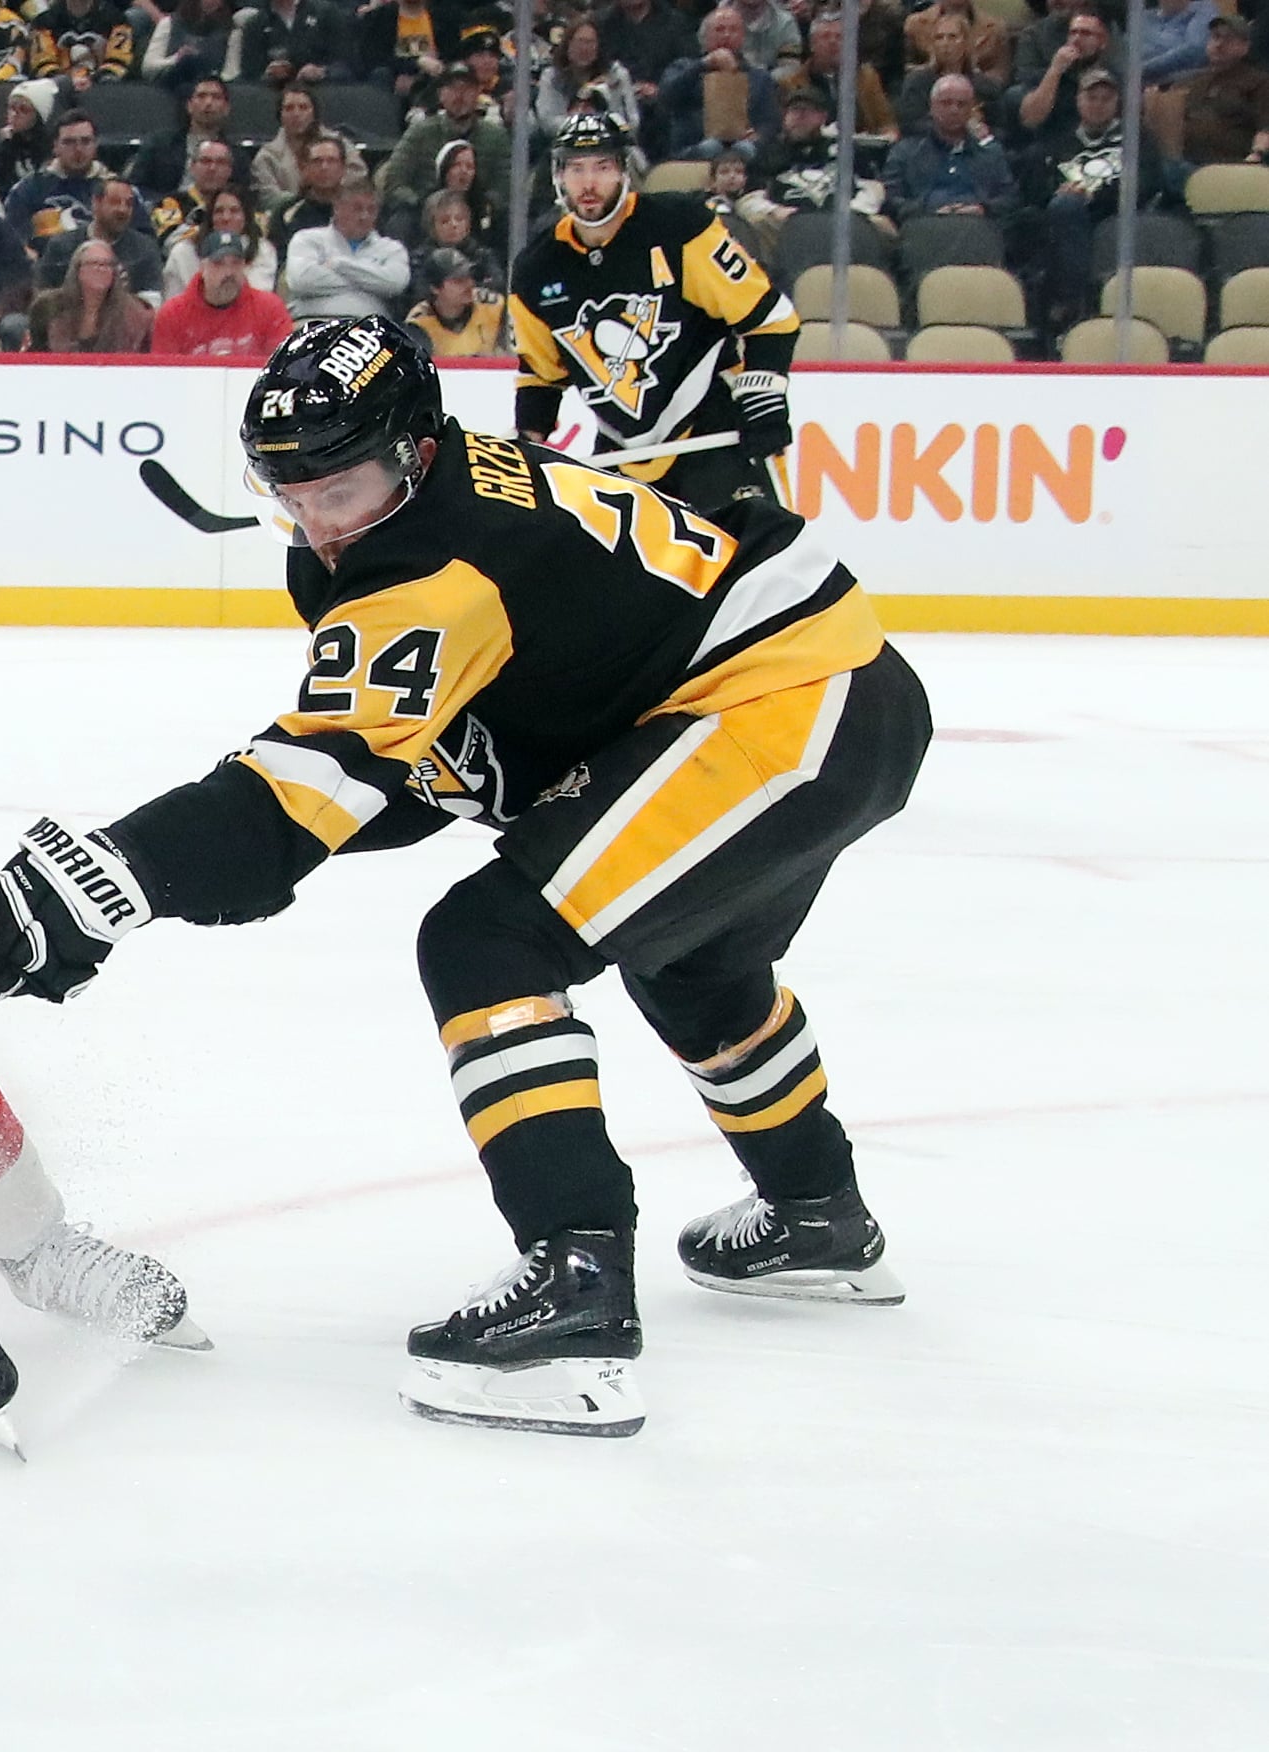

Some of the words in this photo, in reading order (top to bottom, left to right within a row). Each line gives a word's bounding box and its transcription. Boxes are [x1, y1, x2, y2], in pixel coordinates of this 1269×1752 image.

[650, 246, 676, 289] A
[319, 327, 383, 385] BOLD
[349, 347, 394, 394] PENGUIN
[261, 386, 298, 419] 24
[464, 432, 537, 510] GRZE
[298, 621, 447, 721] 24
[483, 1309, 542, 1339] BAUER
